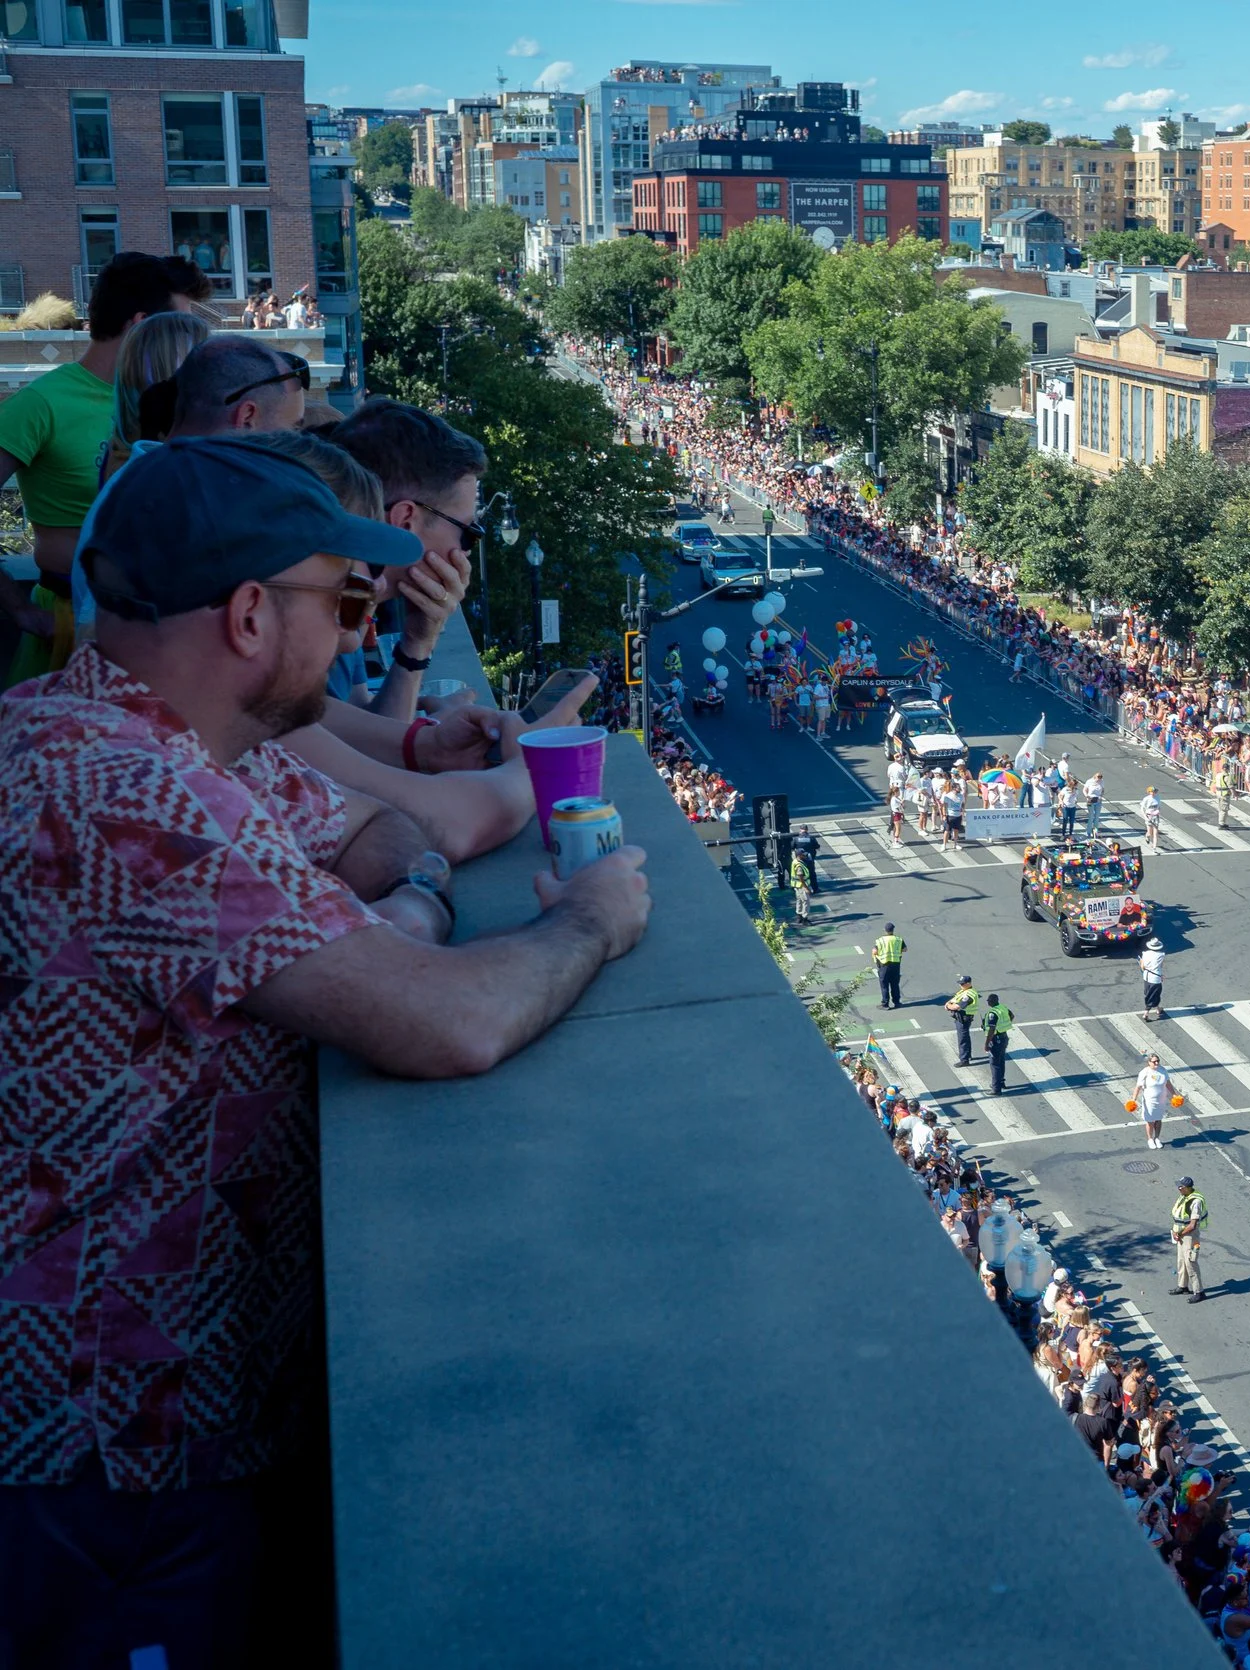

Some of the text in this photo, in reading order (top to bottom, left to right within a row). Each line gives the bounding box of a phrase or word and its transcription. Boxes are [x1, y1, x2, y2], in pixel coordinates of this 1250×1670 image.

[796, 198, 849, 206] THE HARPER
[1088, 901, 1108, 914] RAMI
